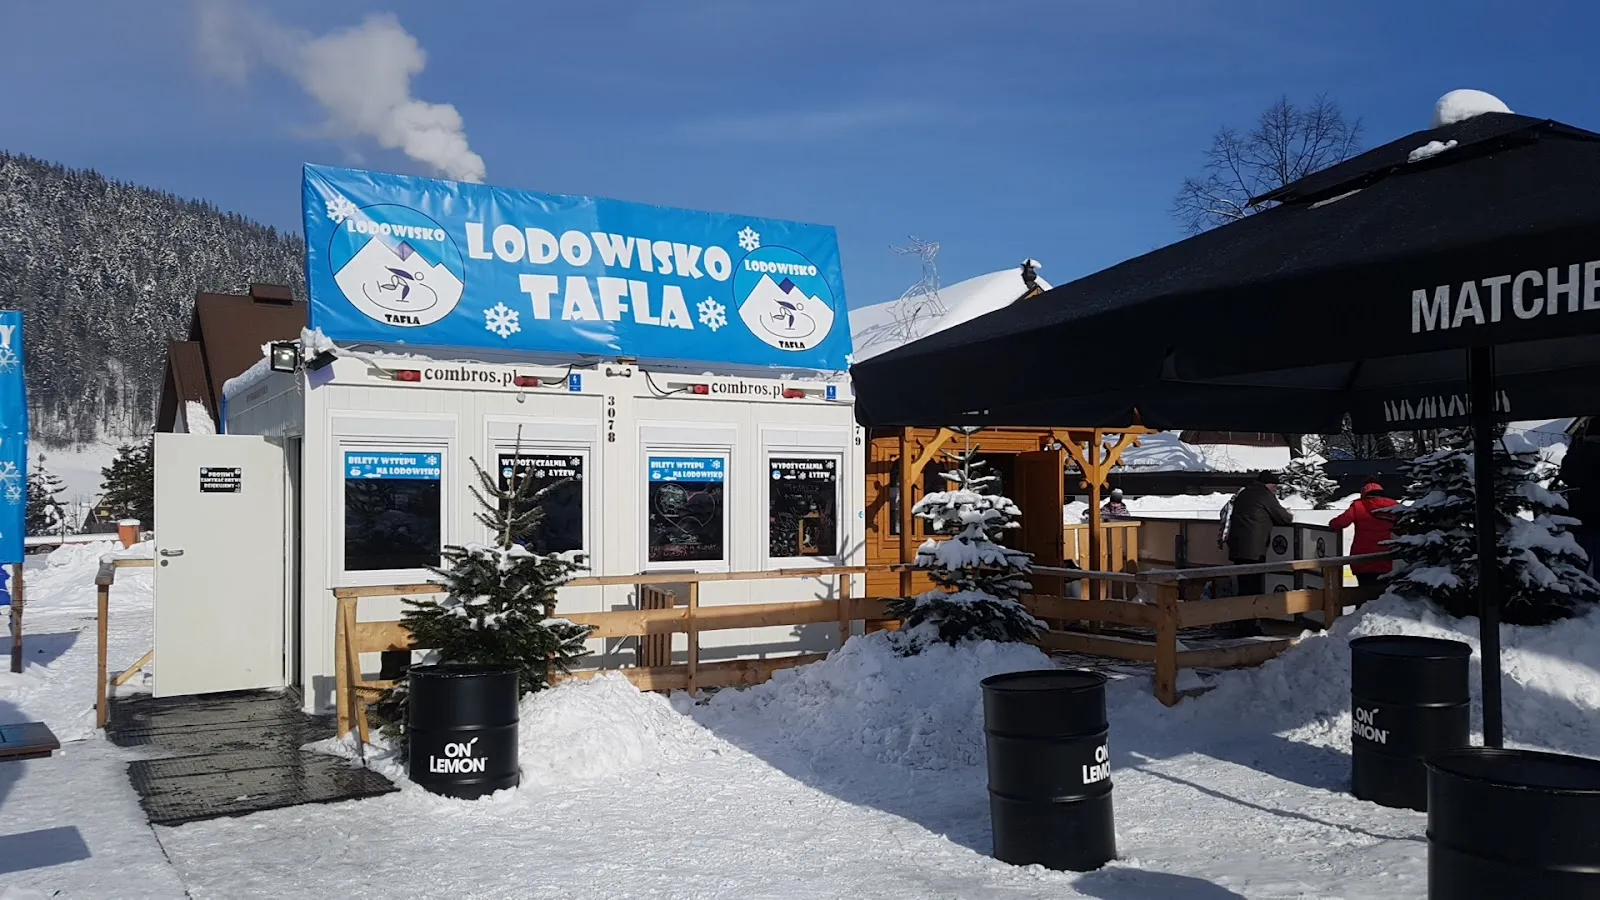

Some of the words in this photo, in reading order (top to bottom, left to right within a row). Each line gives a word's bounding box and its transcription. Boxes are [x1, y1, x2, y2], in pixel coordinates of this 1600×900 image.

[347, 219, 446, 241] LODOWISKO
[466, 222, 732, 281] LODOWISKO
[744, 259, 818, 276] LODOWISKO
[519, 274, 694, 330] TAFLA
[384, 314, 421, 325] TAFLA
[778, 340, 806, 349] TAFLA
[424, 366, 517, 387] combros.pl
[711, 380, 785, 398] combros.pl
[608, 395, 616, 443] 3078
[348, 456, 379, 465] BILETY
[380, 457, 417, 466] WSTĘPU
[650, 461, 675, 469] BILETY
[375, 467, 388, 475] NA
[389, 467, 440, 476] LODOWISKO
[672, 470, 682, 478] NA
[683, 470, 723, 479] LODOWISKO
[1356, 707, 1374, 726] ON
[444, 740, 474, 758] ON
[1095, 743, 1109, 763] ON
[429, 755, 486, 773] LEMON
